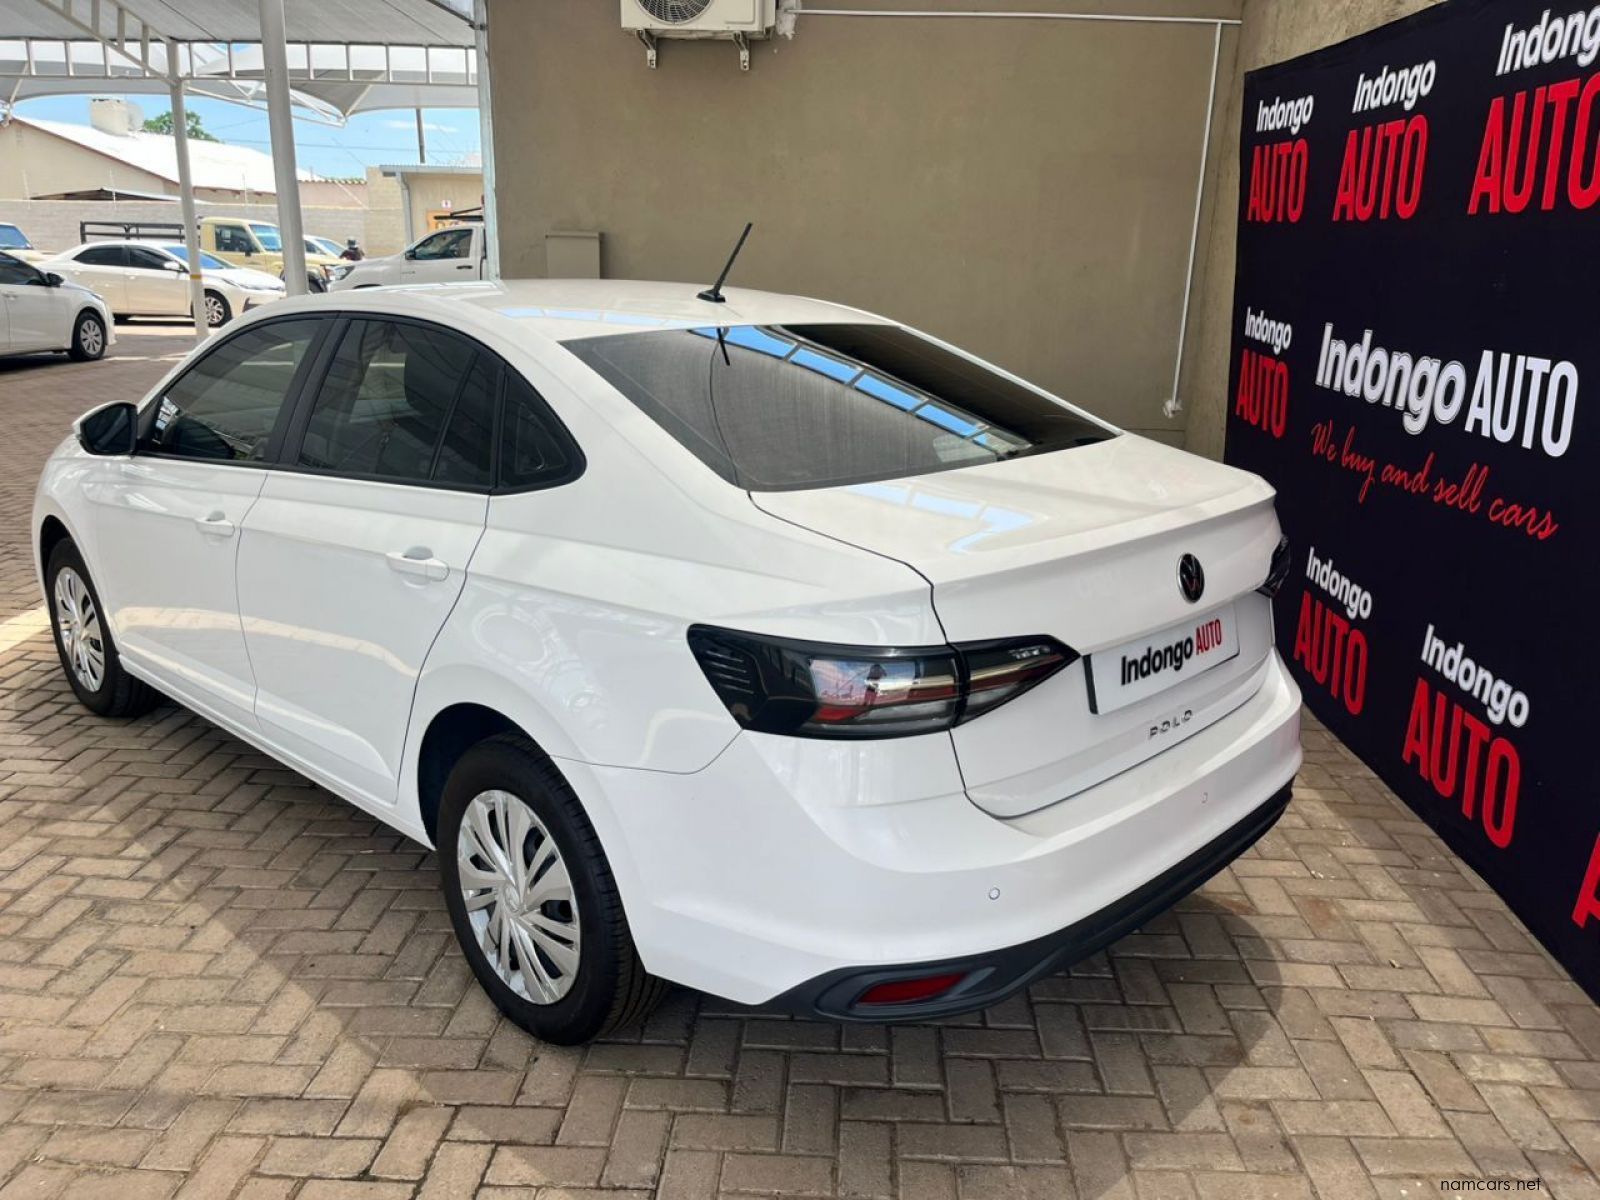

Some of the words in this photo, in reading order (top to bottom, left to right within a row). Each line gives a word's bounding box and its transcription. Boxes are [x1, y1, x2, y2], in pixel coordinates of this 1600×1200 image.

[1255, 94, 1314, 136] Indongo
[1351, 60, 1437, 113] Indongo
[1247, 138, 1309, 223] AUTO
[1332, 114, 1430, 222] AUTO
[1467, 71, 1600, 215] AUTO
[1244, 306, 1292, 355] Indongo
[1235, 349, 1289, 439] AUTO
[1315, 322, 1467, 436] Indongo
[1464, 349, 1579, 458] AUTO
[1311, 420, 1337, 462] We
[1341, 426, 1375, 503] buy
[1381, 452, 1434, 495] and
[1434, 463, 1489, 514] sell
[1488, 498, 1559, 540] cars
[1306, 546, 1372, 620] Indongo
[1121, 636, 1194, 686] Indongo
[1196, 618, 1222, 655] AUTO
[1293, 591, 1368, 715] AUTO
[1421, 623, 1530, 728] Indongo
[1149, 709, 1193, 739] POLO
[1402, 677, 1521, 849] AUTO
